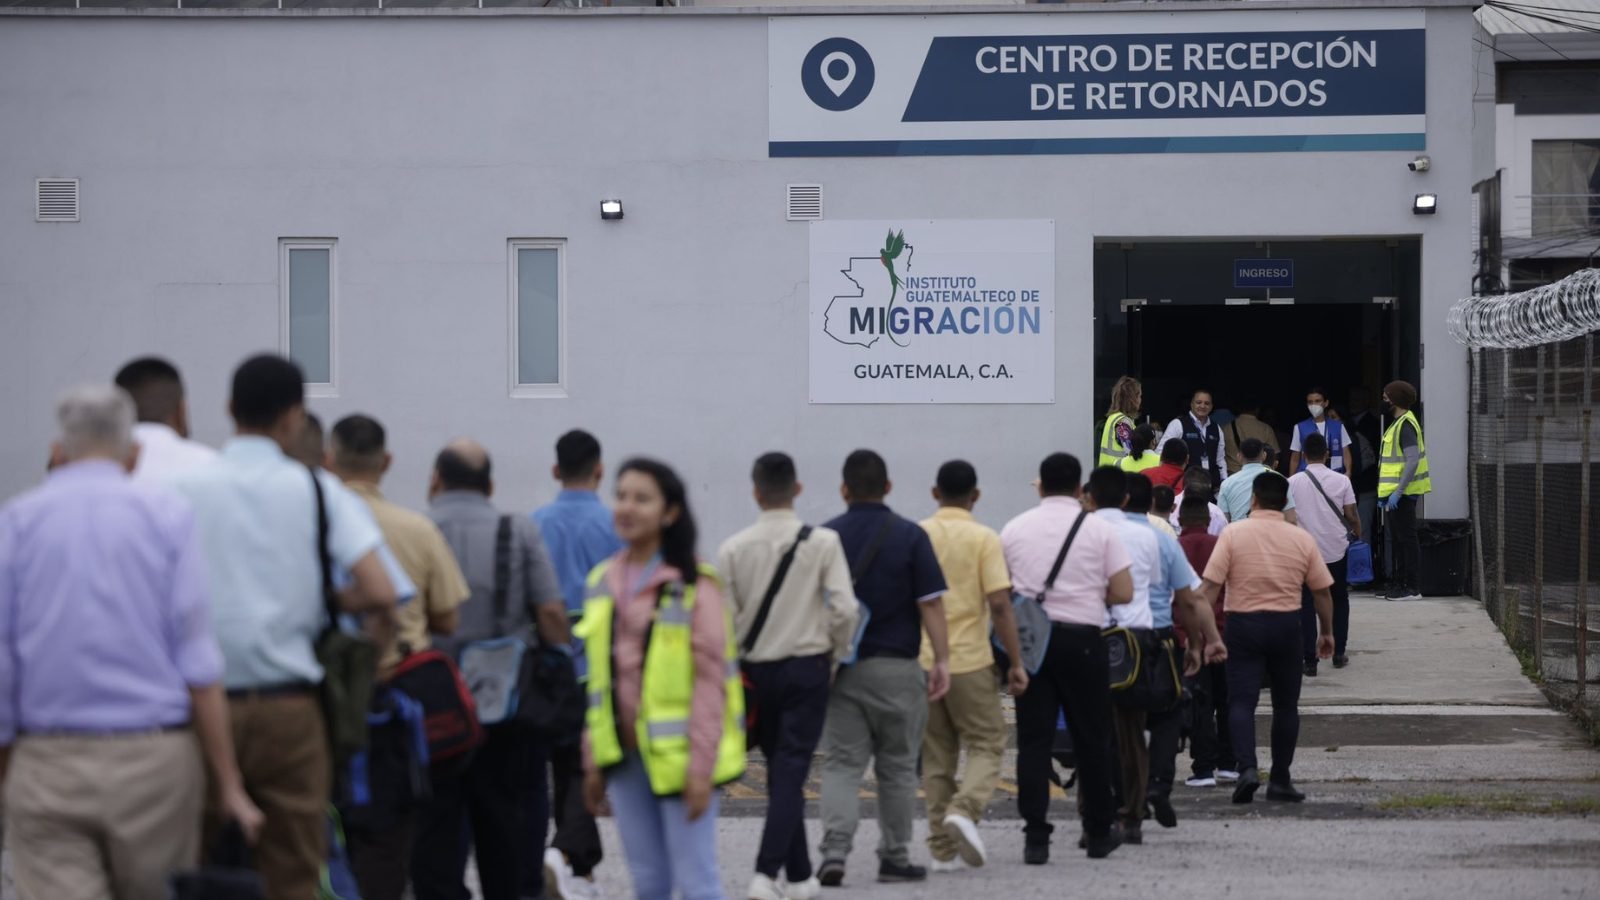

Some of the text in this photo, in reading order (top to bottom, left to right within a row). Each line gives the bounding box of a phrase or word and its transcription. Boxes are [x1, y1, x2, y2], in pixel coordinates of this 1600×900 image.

[975, 37, 1377, 74] CENTRO DE RECEPCIÓN
[1030, 79, 1327, 111] DE RETORNADOS
[1238, 268, 1289, 279] INGRESO
[905, 276, 977, 289] INSTITUTO
[905, 290, 1040, 303] GUATEMALTECO DE
[849, 303, 1041, 335] MIGRACIÓN
[853, 364, 1014, 380] GUATEMALA, C.A.
